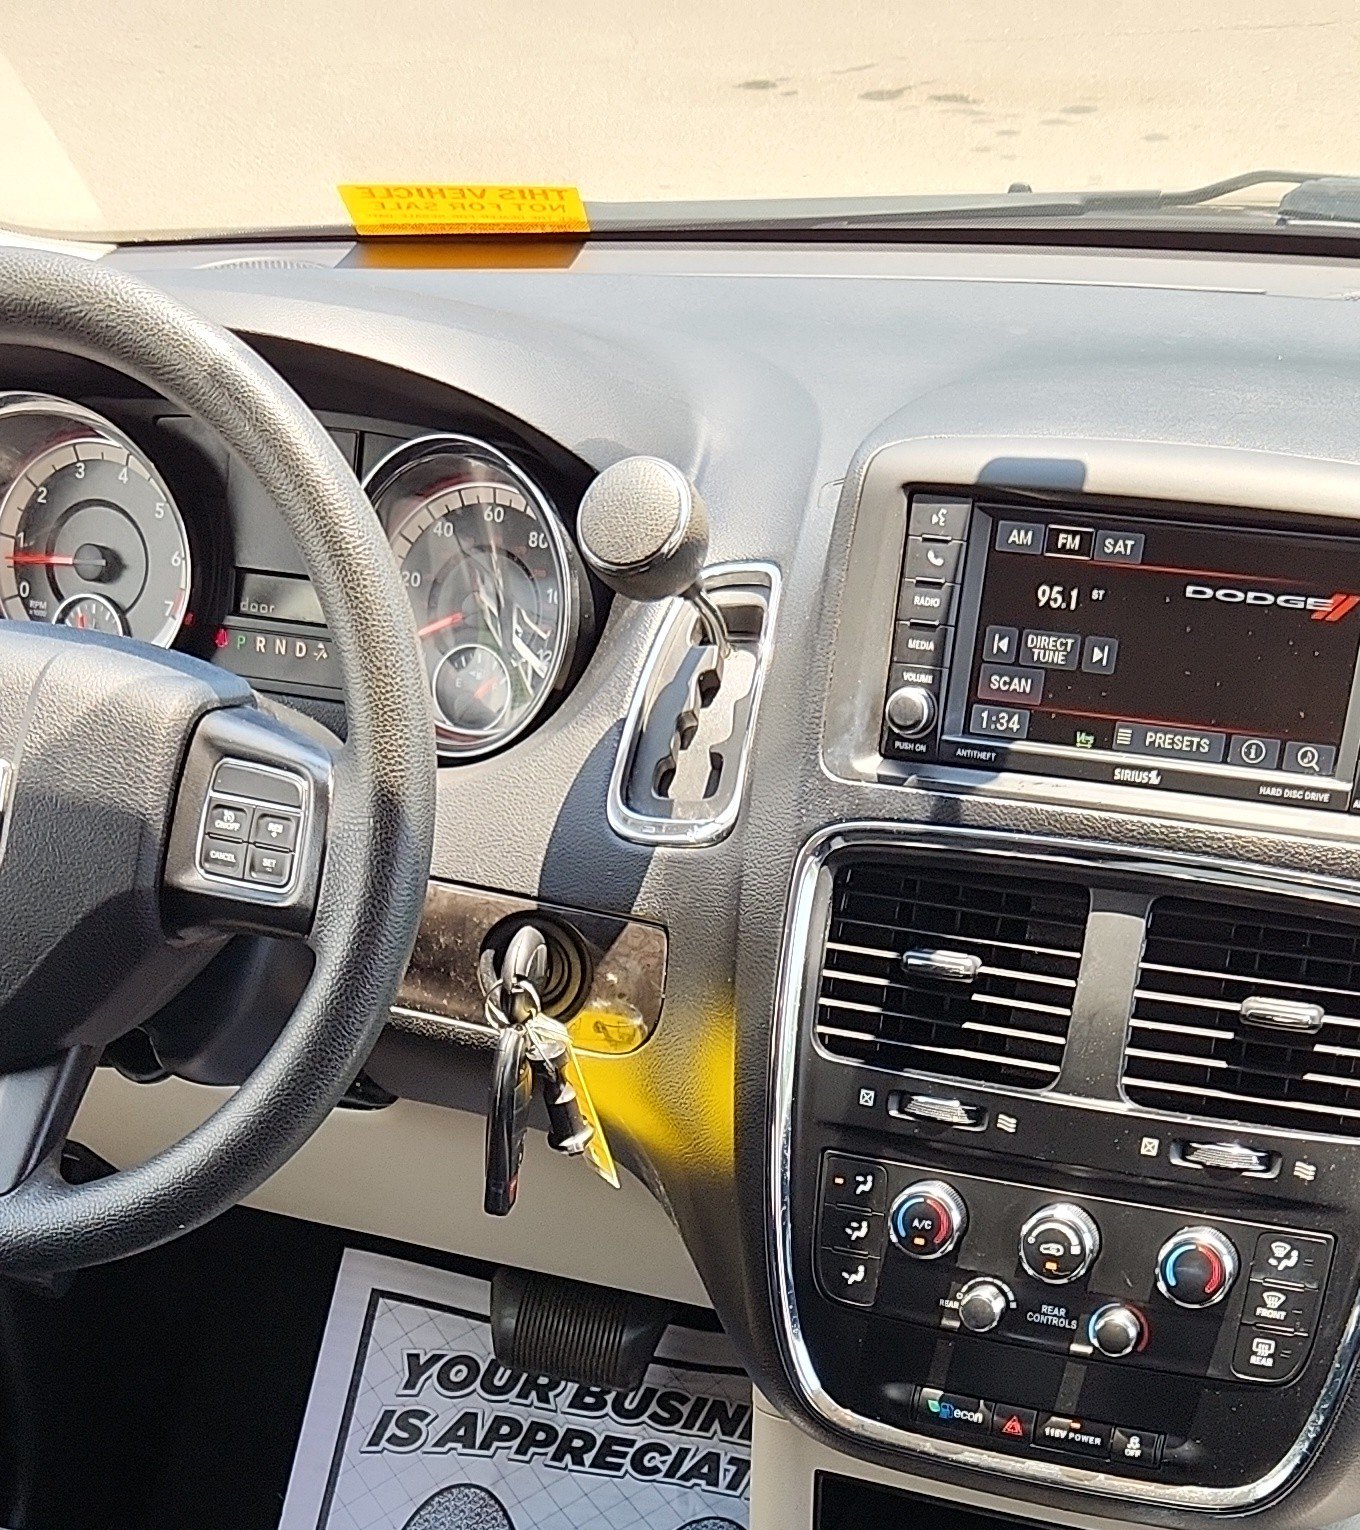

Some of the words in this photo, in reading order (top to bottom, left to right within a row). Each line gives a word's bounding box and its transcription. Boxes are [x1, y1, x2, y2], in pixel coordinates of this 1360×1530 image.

[74, 462, 85, 479] 3
[118, 467, 129, 484] 4
[37, 487, 48, 504] 2
[154, 503, 165, 519] 5
[483, 506, 504, 523] 60
[432, 521, 454, 538] 40
[1007, 529, 1033, 546] AM
[17, 531, 26, 548] 1
[1057, 533, 1081, 551] FM
[1103, 538, 1135, 556] SAT
[171, 550, 181, 567] 6
[19, 581, 30, 598] 0
[1037, 584, 1079, 610] 95.1
[240, 597, 275, 614] door
[914, 595, 940, 608] RADIO
[1185, 585, 1334, 612] DODGE
[164, 600, 174, 617] 7
[237, 634, 246, 650] P
[256, 636, 267, 653] R
[275, 638, 287, 655] N
[295, 641, 307, 658] D
[907, 638, 935, 652] MEDIA
[1027, 634, 1075, 653] DIRECT
[1031, 648, 1067, 665] TUNE
[902, 671, 933, 684] VOLUME
[989, 674, 1032, 695] SCAN
[979, 710, 1021, 733] 1:34
[894, 740, 914, 751] PUSH
[915, 742, 927, 753] ON
[1144, 730, 1210, 753] PRESETS
[956, 747, 997, 763] ANTITHEFT
[1113, 767, 1152, 784] SIRIUS
[1258, 785, 1283, 798] HARD
[1283, 788, 1303, 801] DISC
[1304, 791, 1331, 804] DRIVE
[911, 1217, 932, 1230] A/C
[939, 1298, 960, 1310] REAR
[1041, 1304, 1066, 1318] REAR
[1026, 1312, 1078, 1330] CONTROLS
[1255, 1306, 1287, 1321] FRONT
[400, 1351, 561, 1408] YOUR
[566, 1384, 752, 1445] BUSIN
[953, 1407, 983, 1424] econ
[363, 1405, 437, 1452] IS
[1068, 1431, 1102, 1446] POWER
[1124, 1448, 1142, 1458] OFF
